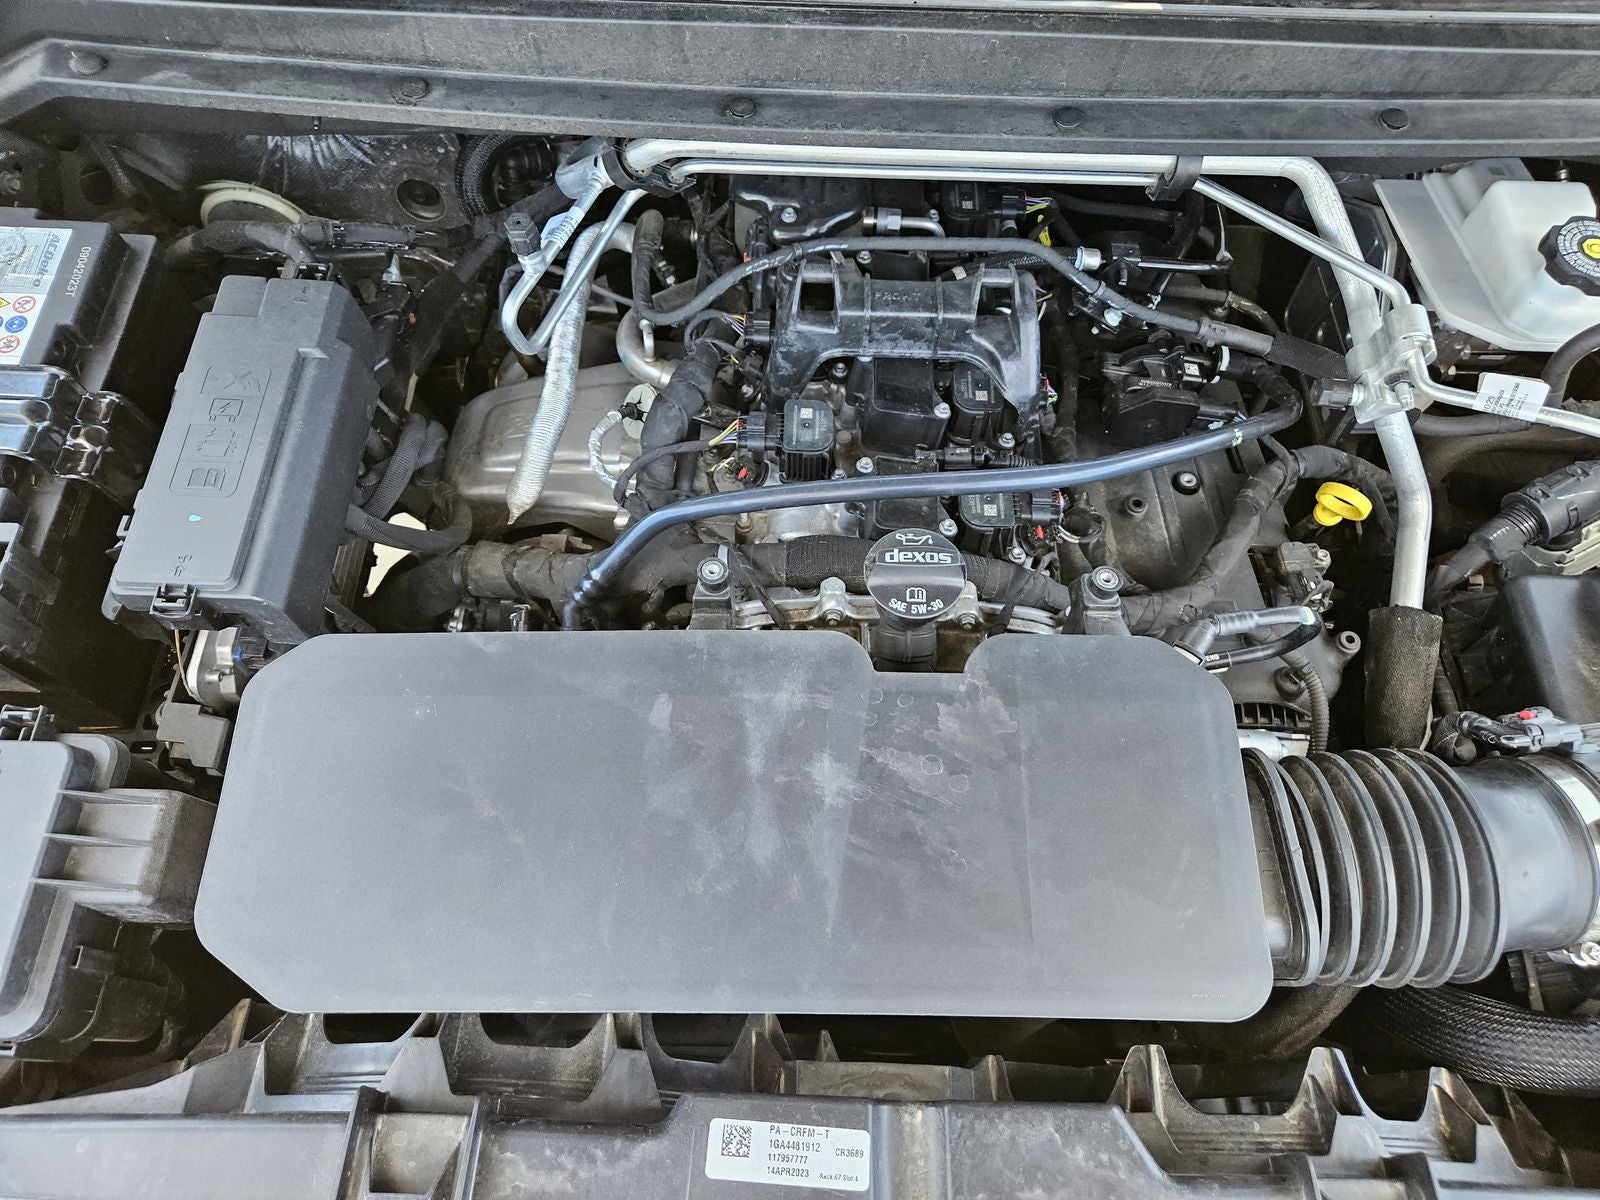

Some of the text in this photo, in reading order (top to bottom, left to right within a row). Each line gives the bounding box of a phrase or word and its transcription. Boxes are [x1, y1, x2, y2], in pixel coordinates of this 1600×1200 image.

[65, 246, 92, 297] 09042023T
[884, 548, 954, 563] dexos
[888, 598, 944, 615] SAE 5W-30
[769, 1138, 821, 1153] 1GA4481912
[835, 1147, 864, 1158] CR3689
[767, 1152, 808, 1164] 117957777
[767, 1165, 810, 1178] 14APR2023
